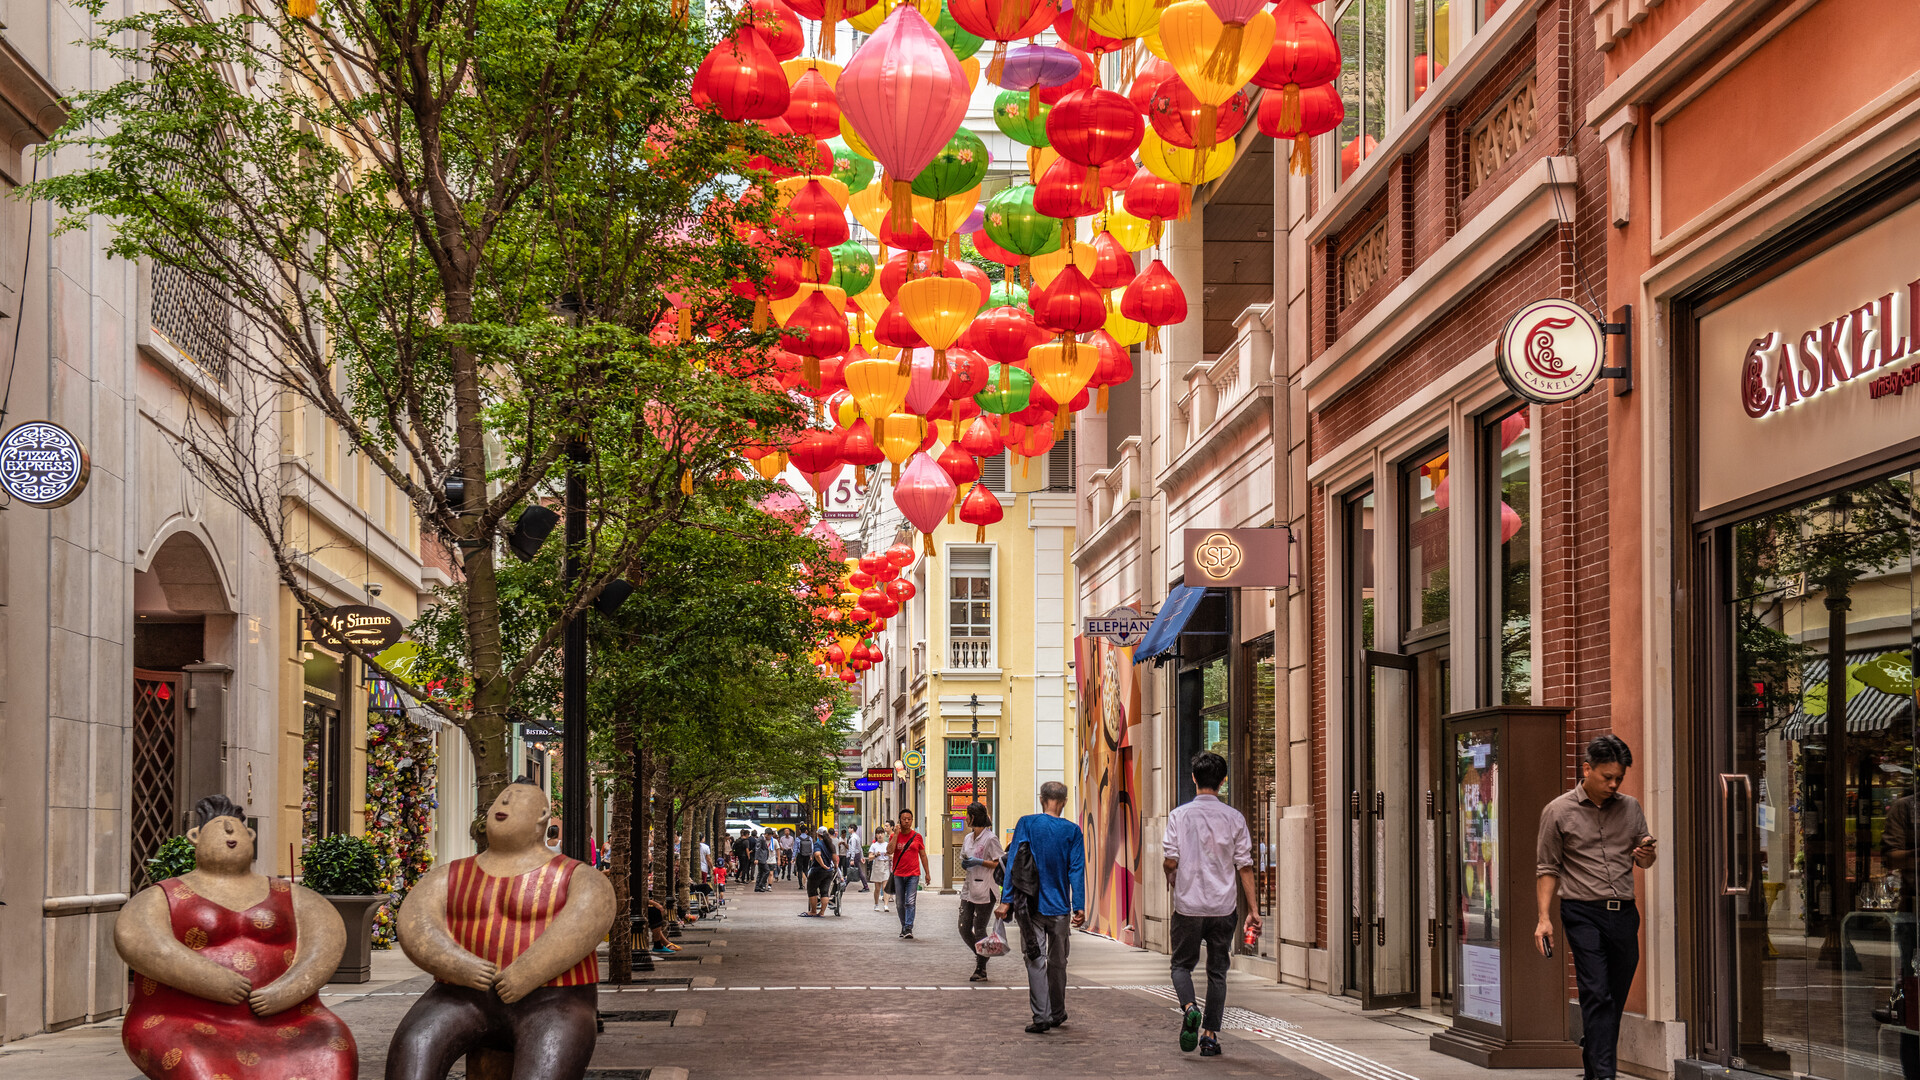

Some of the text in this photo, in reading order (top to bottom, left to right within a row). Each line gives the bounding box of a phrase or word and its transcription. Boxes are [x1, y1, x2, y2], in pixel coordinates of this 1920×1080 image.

[1524, 370, 1583, 390] CASKELLS
[1869, 372, 1904, 399] Whisky
[18, 450, 60, 461] PIZZA
[5, 460, 73, 472] EXPRESS
[1206, 546, 1233, 567] SP
[347, 613, 391, 628] Simms
